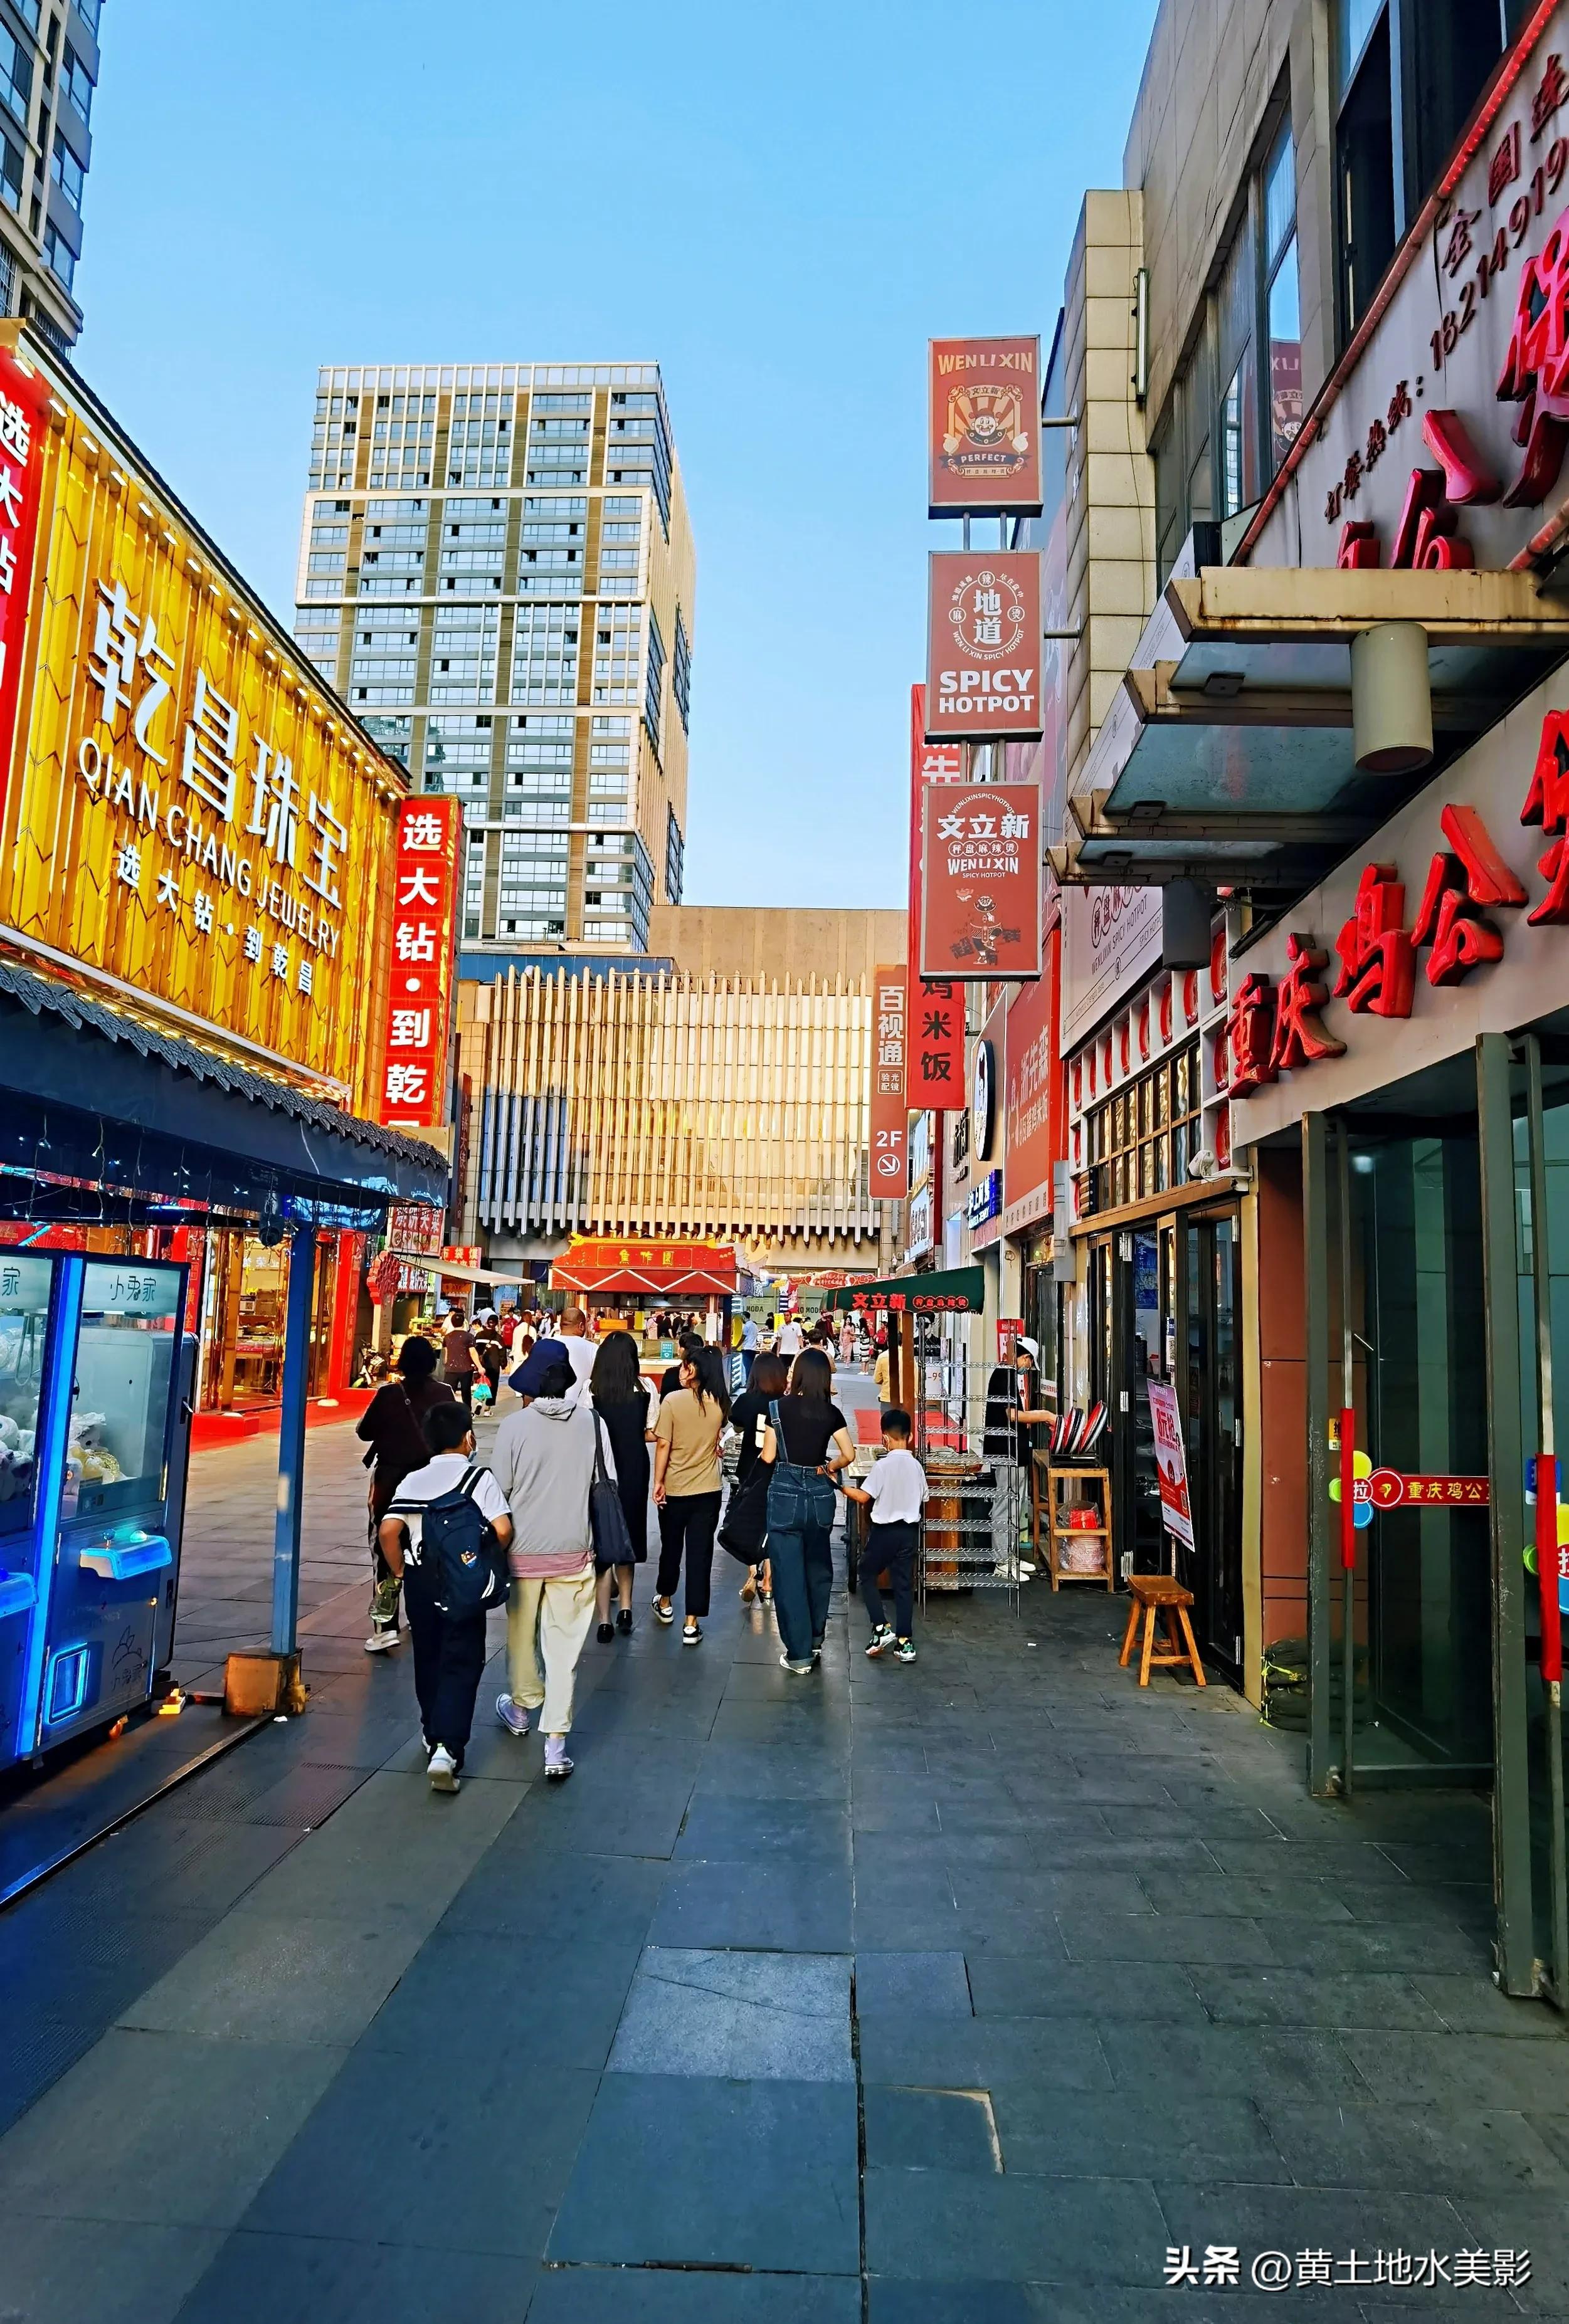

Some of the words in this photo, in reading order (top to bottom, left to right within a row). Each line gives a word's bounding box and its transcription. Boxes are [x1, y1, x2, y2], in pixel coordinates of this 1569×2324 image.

[961, 453, 1006, 463] PERFECT
[973, 589, 1002, 644] 地道
[984, 651, 1004, 660] SPICY
[1005, 629, 1024, 654] HOTPOT
[939, 669, 1033, 694] SPICY
[939, 695, 1035, 713] HOTPOT
[88, 579, 348, 910] 乾昌珠宝
[937, 813, 1029, 839] 文立新
[78, 737, 159, 832] QIAN
[167, 804, 251, 896] CHANG
[256, 875, 339, 959] JEWELRY
[1112, 922, 1126, 949] SPICY
[1127, 894, 1148, 933] HOTPOT
[878, 986, 904, 1066] 百视通
[881, 1073, 900, 1082] 验光
[881, 1083, 900, 1091] 配镜
[876, 1131, 903, 1148] 2F
[852, 1292, 906, 1309] 文立新
[1407, 1481, 1489, 1500] 重庆鸡公
